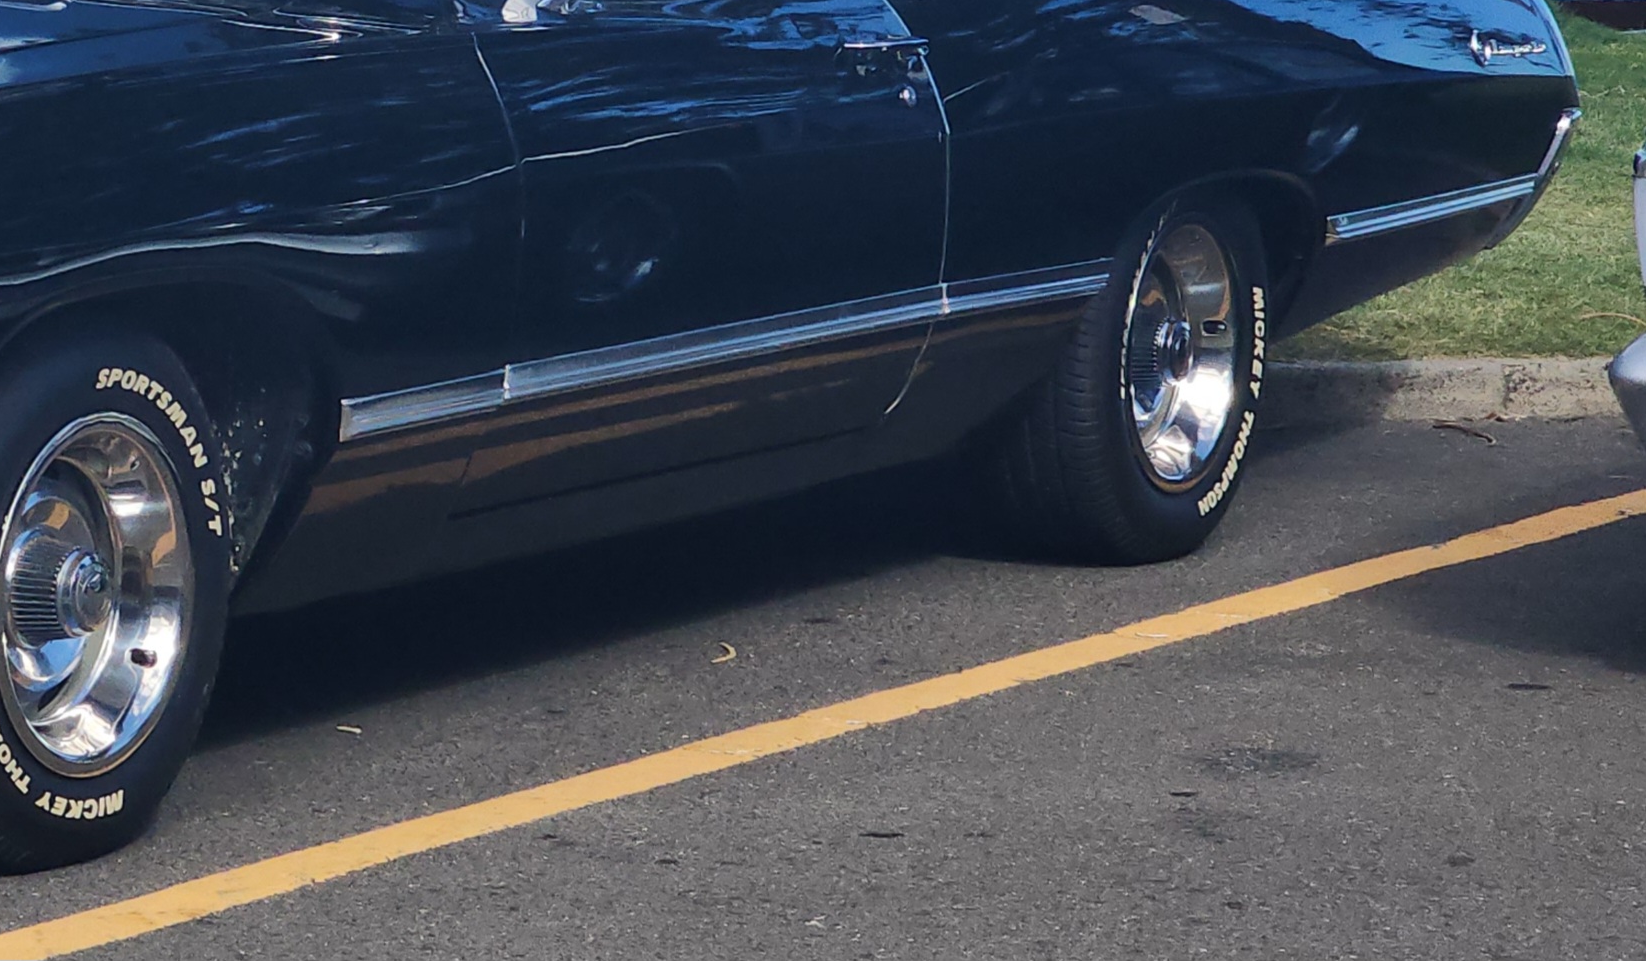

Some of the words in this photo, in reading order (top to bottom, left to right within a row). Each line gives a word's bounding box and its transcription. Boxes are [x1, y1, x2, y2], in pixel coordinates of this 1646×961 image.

[1250, 286, 1266, 399] MICKEY
[96, 367, 208, 468] SPORTSMAN
[200, 477, 223, 536] S/T
[1198, 410, 1255, 516] THOMPSON
[35, 788, 125, 820] MICKEY
